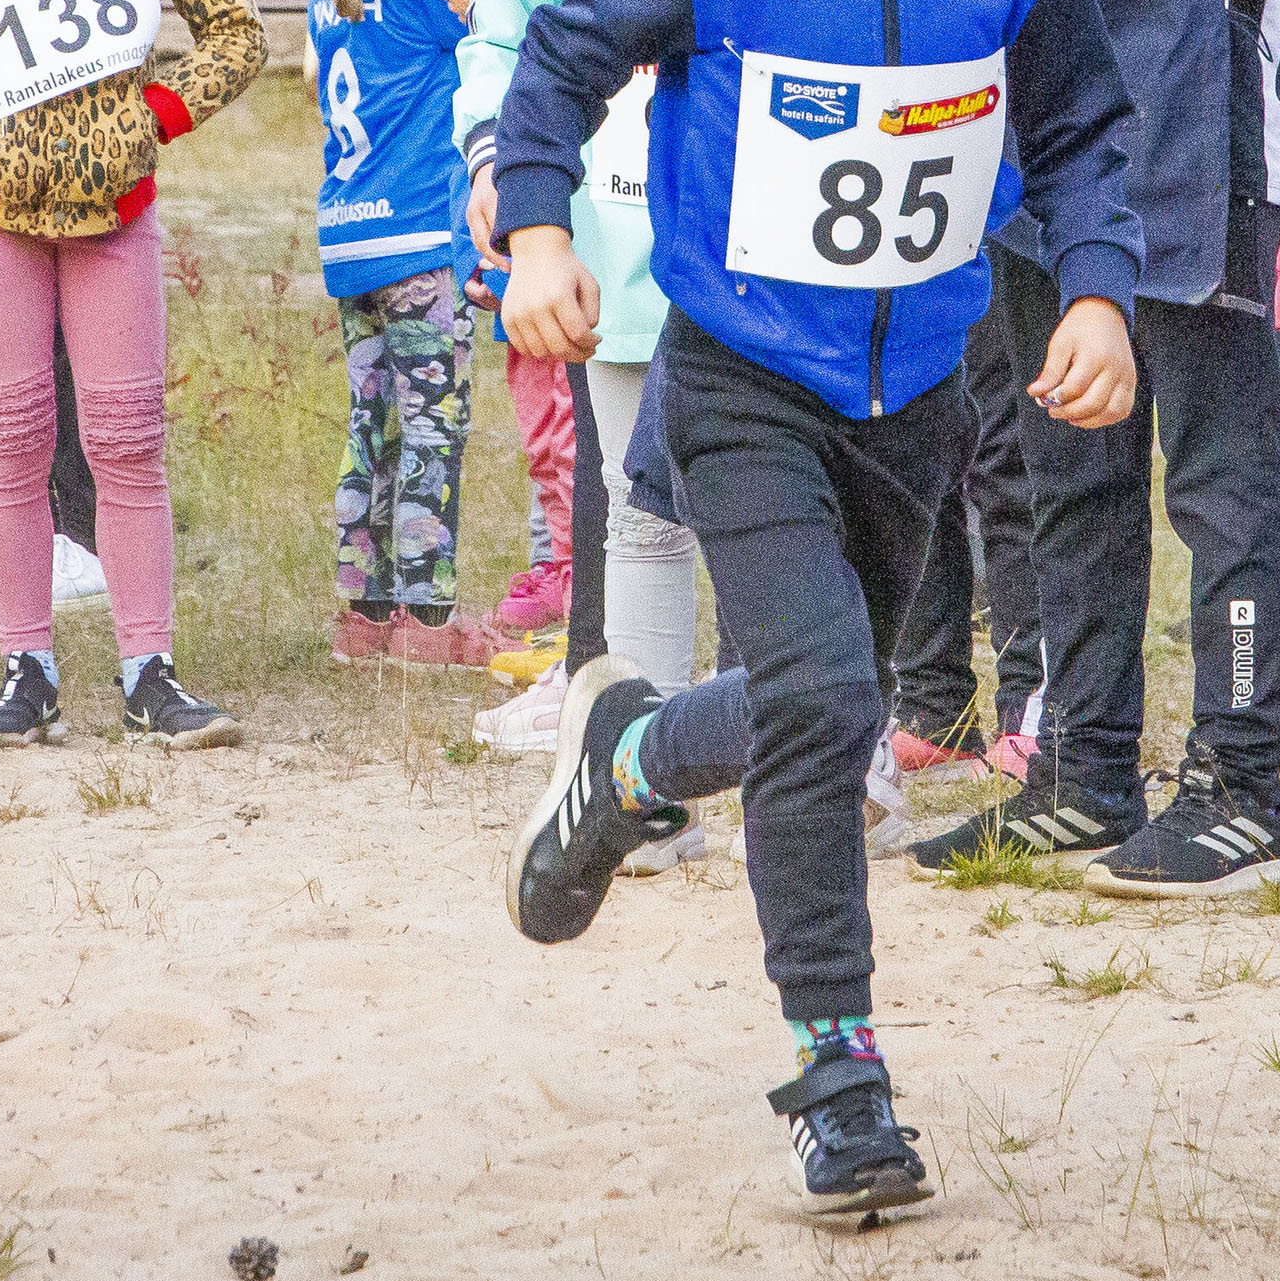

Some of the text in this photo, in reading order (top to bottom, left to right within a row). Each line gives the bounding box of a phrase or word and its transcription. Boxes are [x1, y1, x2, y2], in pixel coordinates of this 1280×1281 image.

[4, 58, 104, 107] Rantalakeus
[327, 47, 372, 182] 8
[906, 90, 988, 126] Halpa-Halli
[781, 108, 805, 120] hotel
[814, 113, 845, 125] safaris
[812, 155, 954, 266] 85
[1232, 629, 1254, 709] reima
